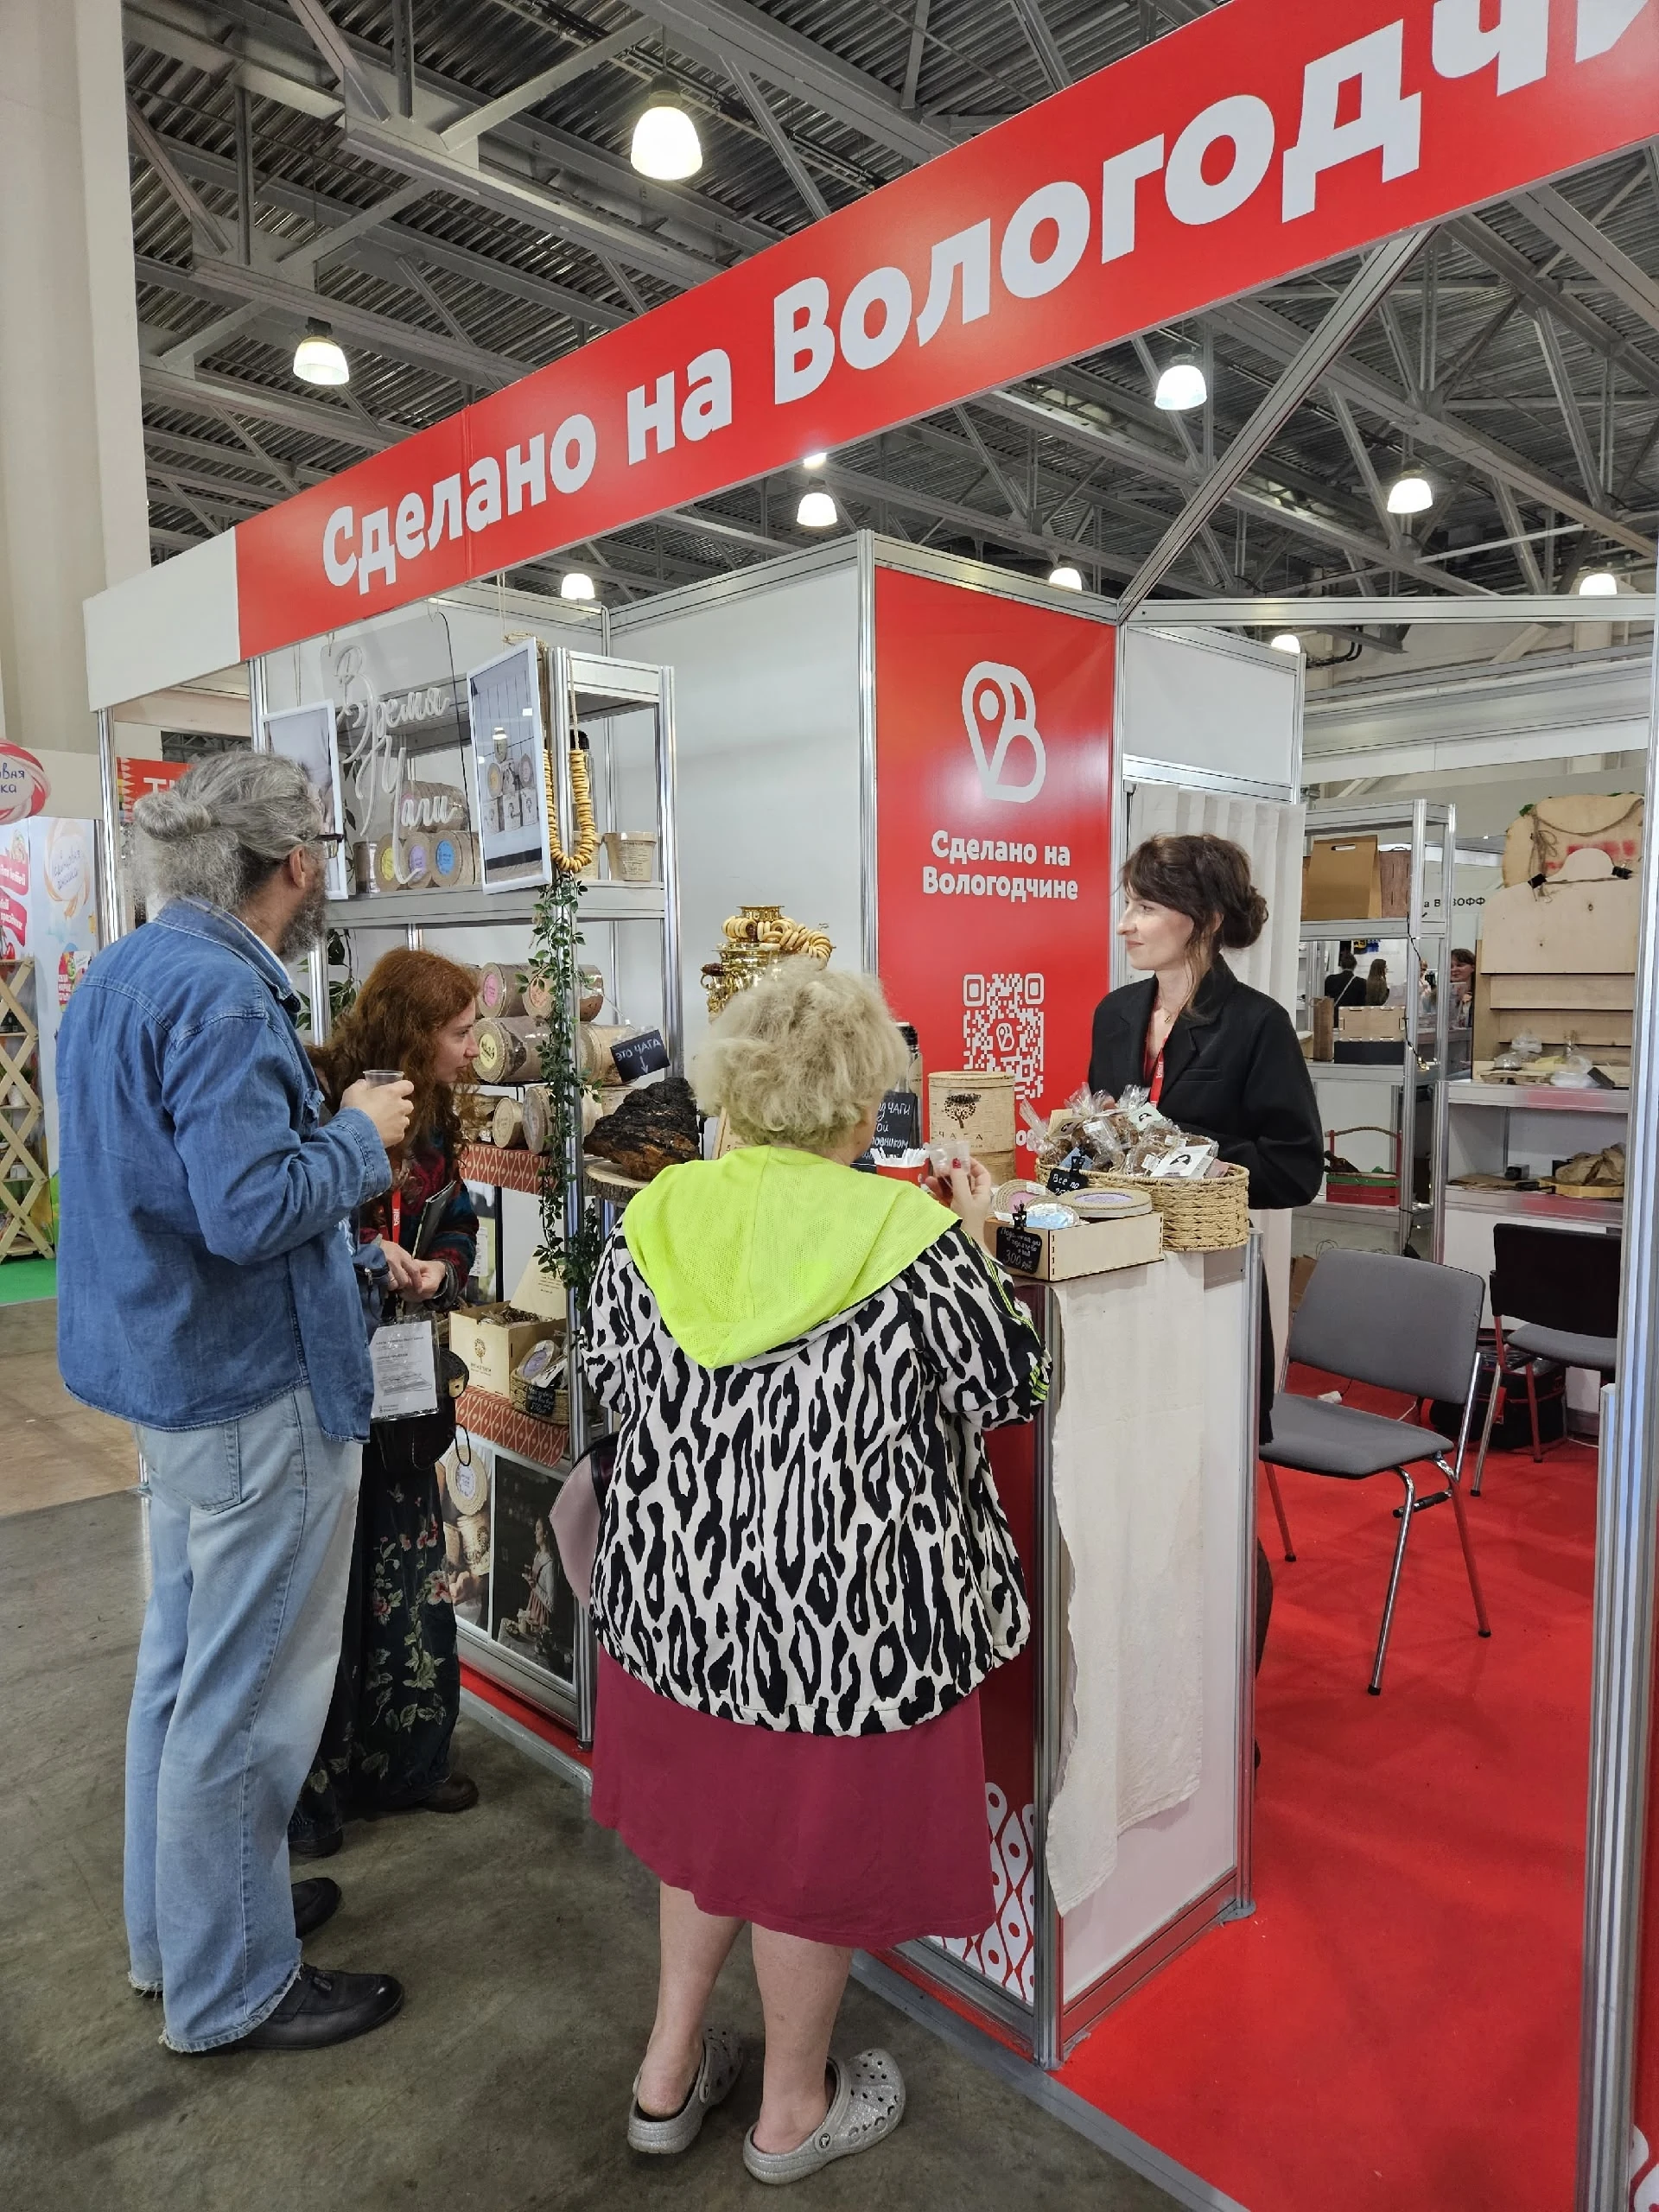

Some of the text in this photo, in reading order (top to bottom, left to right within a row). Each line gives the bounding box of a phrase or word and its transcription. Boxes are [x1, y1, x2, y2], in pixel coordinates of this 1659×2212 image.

[323, 0, 1649, 595] Сделано на Вологодч
[931, 830, 1071, 867] Сделано на
[922, 866, 1078, 903] Вологодчине
[615, 1038, 661, 1062] ЭТО ЧАГА
